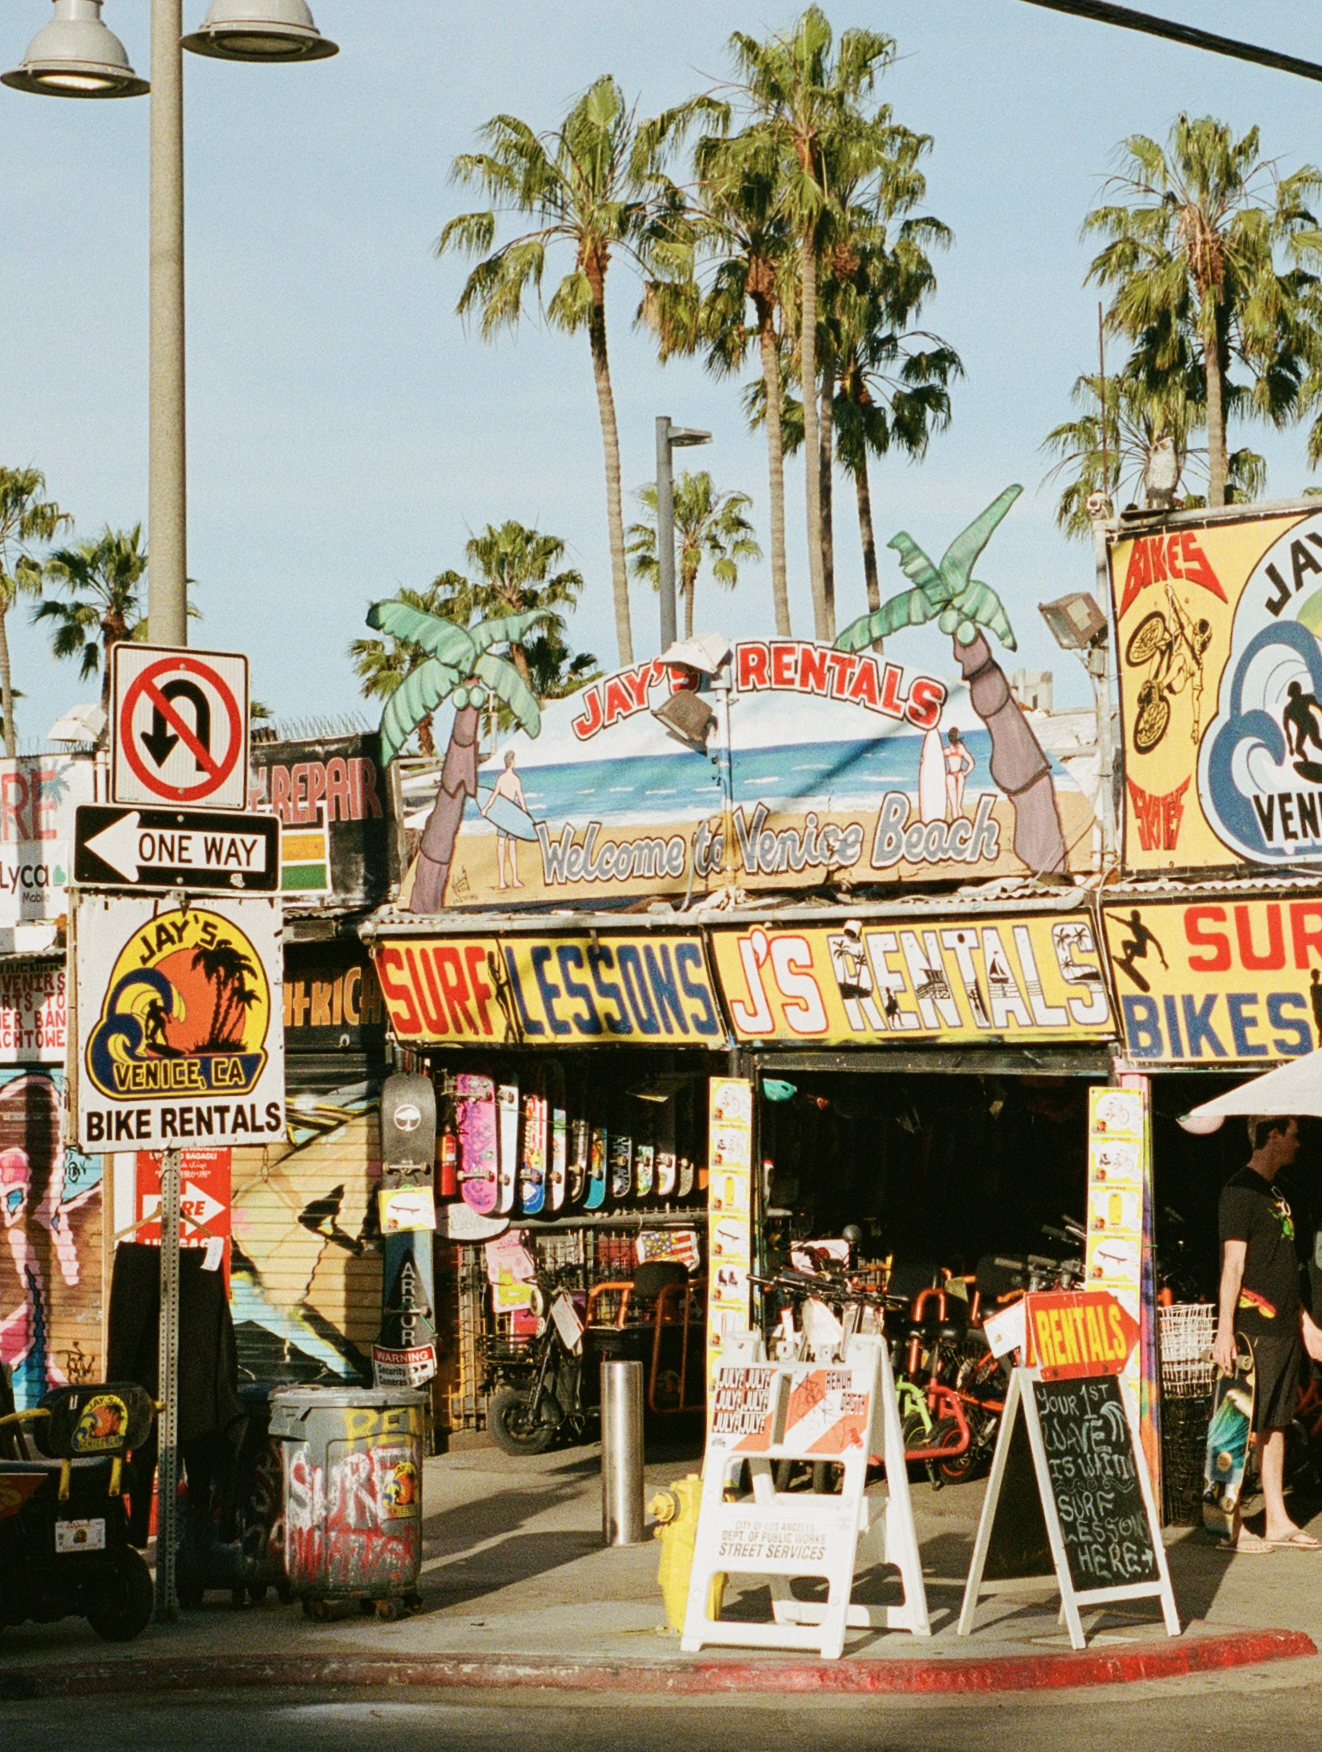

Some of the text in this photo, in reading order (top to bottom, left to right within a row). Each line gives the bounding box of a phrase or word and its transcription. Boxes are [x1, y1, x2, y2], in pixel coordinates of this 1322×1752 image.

[1118, 532, 1228, 622] BIKES
[735, 640, 949, 730] RENTALS
[272, 757, 383, 824] REPAIR
[139, 832, 258, 867] ONE WAY
[533, 819, 686, 886] Welcome
[733, 802, 864, 875] Venice
[870, 791, 1000, 869] Beach
[139, 916, 218, 964] JAY'S
[376, 941, 720, 1037] SURF LESSONS
[731, 921, 1109, 1036] J'S RENTALS
[44, 991, 66, 1010] TO
[1121, 990, 1311, 1060] BIKES
[113, 1057, 245, 1091] VENICE, CA
[86, 1102, 282, 1143] BIKE RENTALS
[1035, 1304, 1127, 1367] RENTALS
[376, 1350, 429, 1363] WARNING
[377, 1364, 406, 1378] Security
[1037, 1384, 1108, 1419] YOUR 1ST
[1042, 1418, 1112, 1454] WAVE
[1049, 1456, 1075, 1479] IS
[1058, 1491, 1115, 1522] SURF
[735, 1520, 750, 1530] CITY
[753, 1521, 762, 1531] OF
[748, 1531, 759, 1543] OF
[761, 1532, 792, 1544] PUBLIC
[795, 1533, 826, 1545] WORKS
[719, 1542, 826, 1560] STREET SERVICES
[1078, 1542, 1141, 1578] HERE
